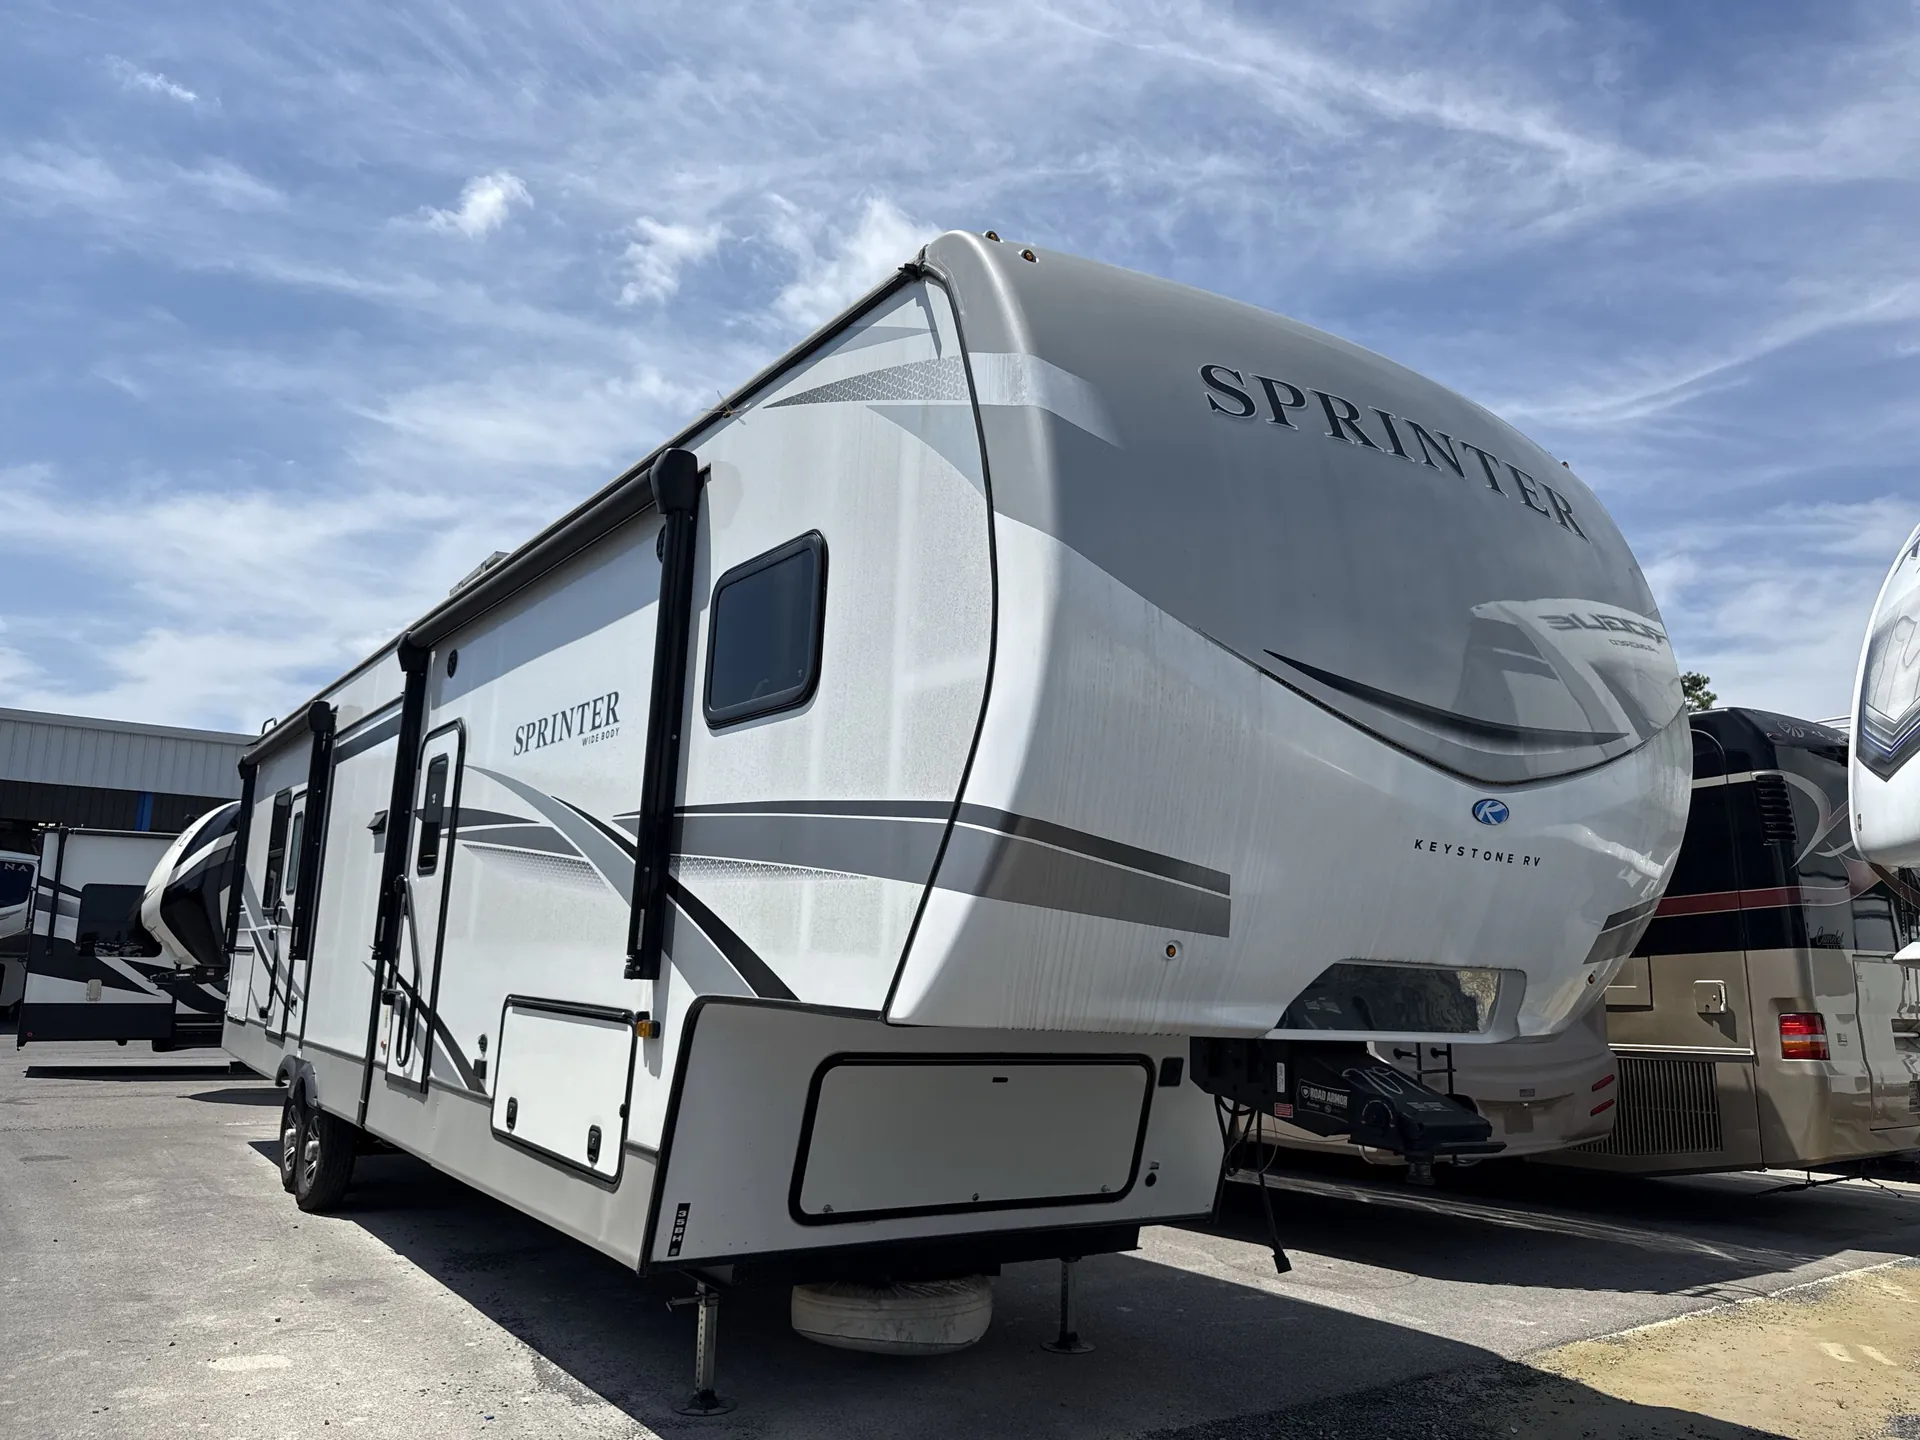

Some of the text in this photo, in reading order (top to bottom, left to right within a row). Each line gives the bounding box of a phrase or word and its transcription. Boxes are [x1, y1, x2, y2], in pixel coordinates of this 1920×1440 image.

[1198, 363, 1591, 545] SPRINTER
[513, 691, 620, 756] SPRINTER
[582, 727, 620, 746] WIDE BODY
[1414, 839, 1541, 867] KEYSTONE RV
[1310, 1087, 1326, 1101] ROAD
[1326, 1091, 1348, 1107] ARMOR
[672, 1210, 687, 1242] 35BH
